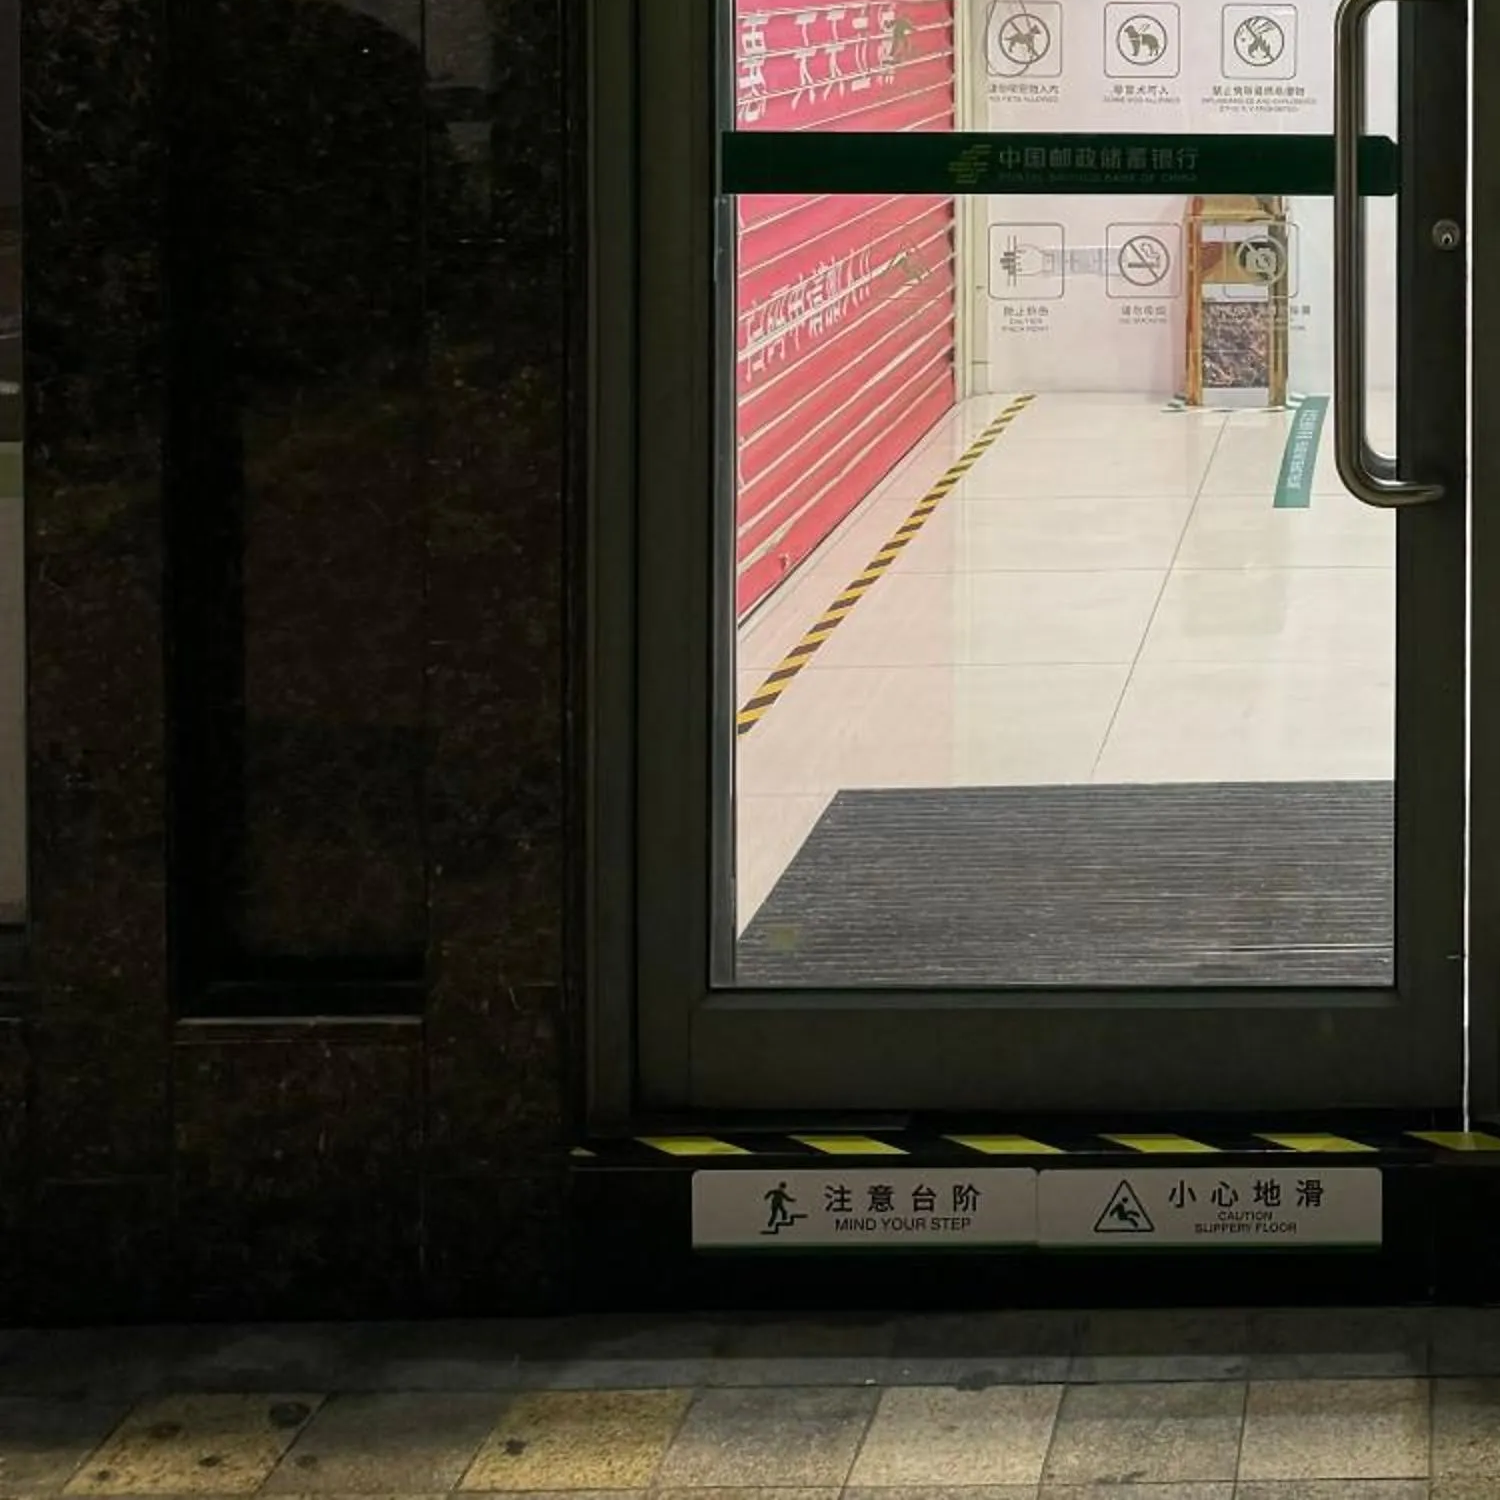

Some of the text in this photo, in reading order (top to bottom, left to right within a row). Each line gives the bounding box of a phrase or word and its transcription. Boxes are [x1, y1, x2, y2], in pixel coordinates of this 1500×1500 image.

[999, 145, 1199, 170] 中国邮政储蓄银行
[824, 1184, 981, 1212] 注意台阶
[1169, 1178, 1324, 1209] 小心地滑
[835, 1217, 971, 1231] MIND YOUR STEP
[1217, 1210, 1273, 1222] CAUTION
[1255, 1222, 1297, 1234] FLOOR
